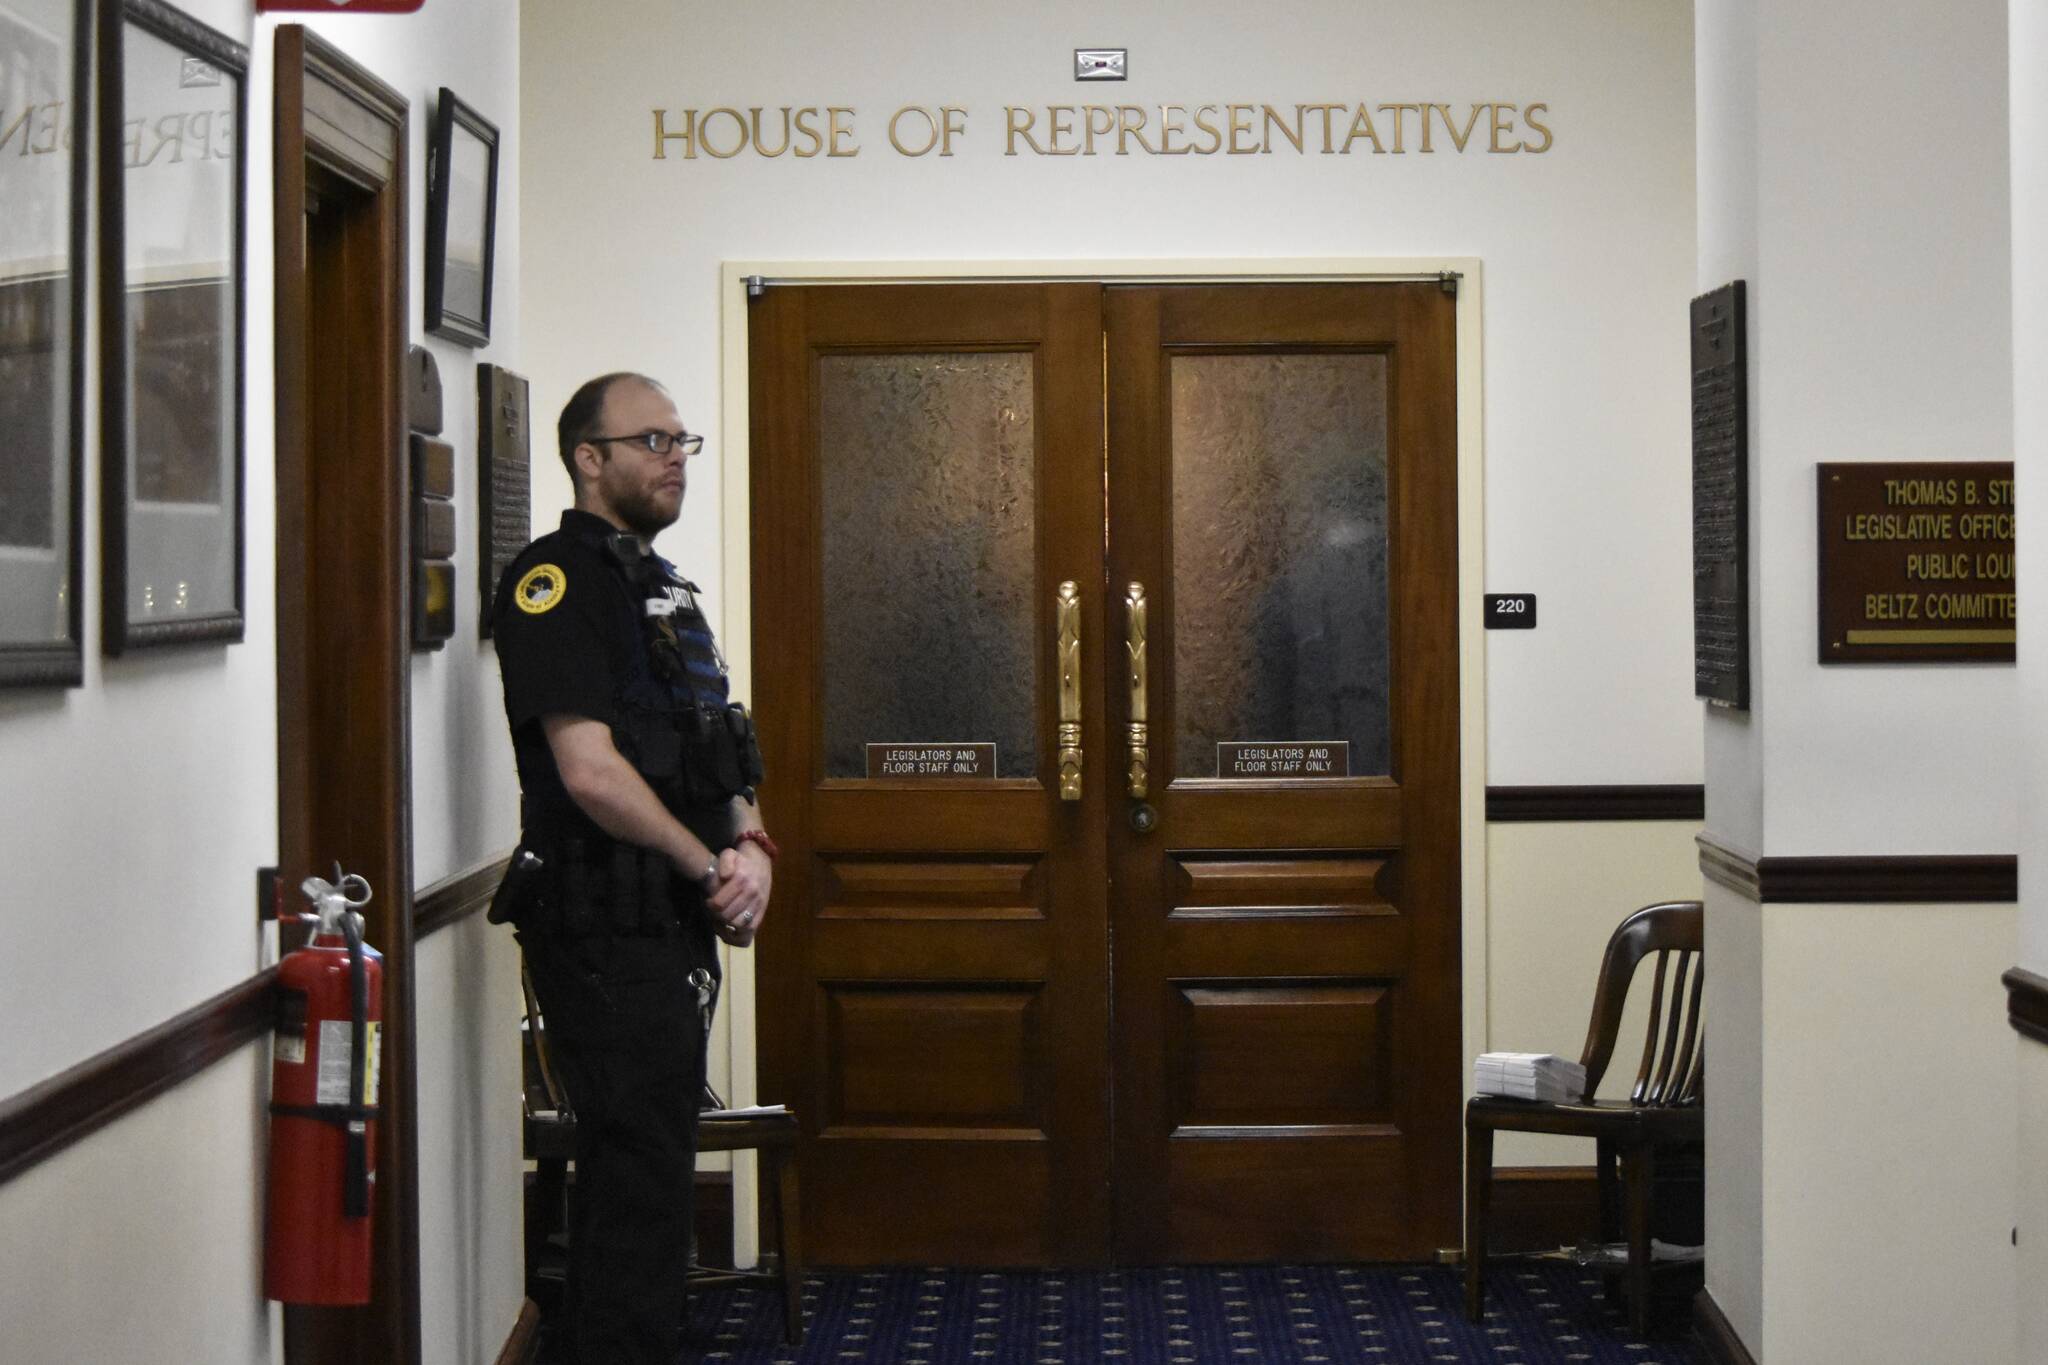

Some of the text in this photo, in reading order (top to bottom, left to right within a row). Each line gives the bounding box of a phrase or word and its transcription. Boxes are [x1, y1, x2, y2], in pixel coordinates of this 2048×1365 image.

[652, 102, 1554, 159] HOUSE OF REPRESENTATIVES
[1884, 479, 1957, 505] THOMAS
[1964, 480, 1981, 505] B.
[1846, 514, 1952, 540] LEGISLATIVE
[1907, 553, 2016, 579] PUBLIC LOU
[1496, 599, 1525, 613] 220
[1865, 594, 1919, 619] BELTZ
[886, 750, 976, 761] LEGISLATORS AND
[1237, 748, 1329, 760] LEGISLATORS AND
[883, 762, 979, 773] FLOOR STAFF ONLY
[1234, 760, 1332, 772] FLOOR STAFF ONLY
